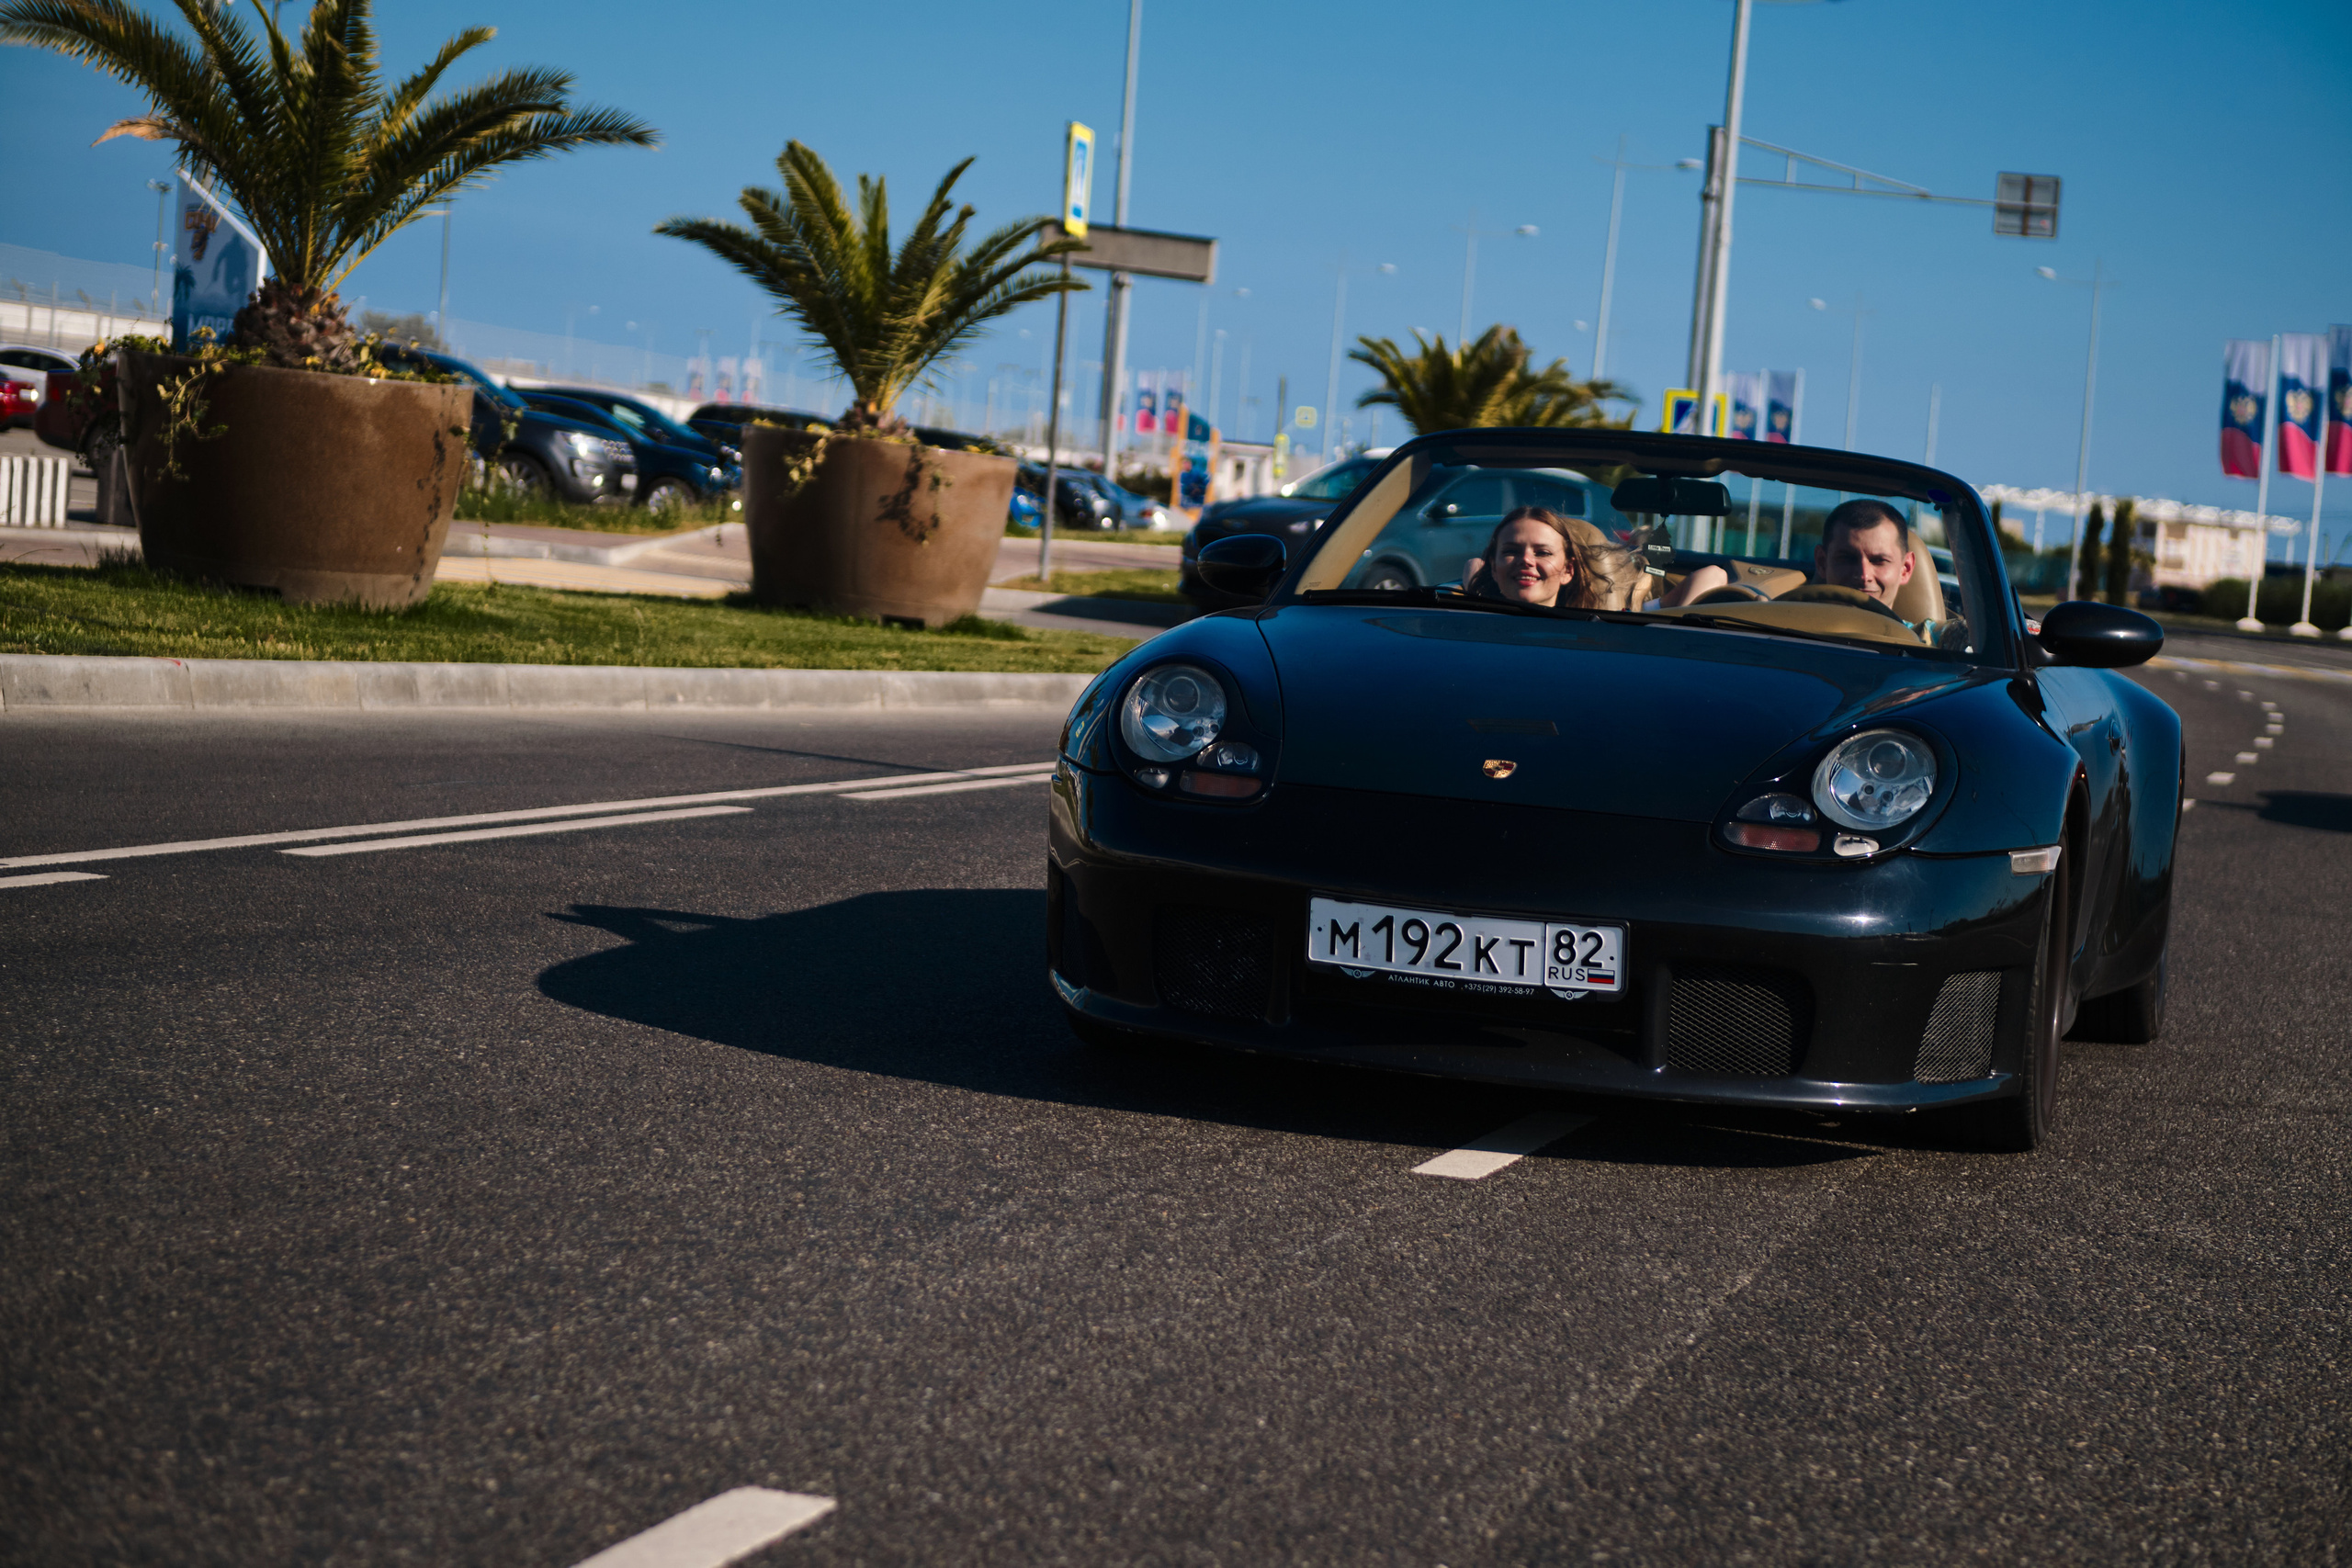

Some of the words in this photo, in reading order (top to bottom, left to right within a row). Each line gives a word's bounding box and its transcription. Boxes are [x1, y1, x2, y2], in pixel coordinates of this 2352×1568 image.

[1554, 929, 1604, 968] 82
[1387, 974, 1430, 986] АТЛАНТИК
[1432, 979, 1455, 988] АВТО
[1498, 986, 1535, 996] 392-58-97
[1548, 966, 1586, 982] RUS
